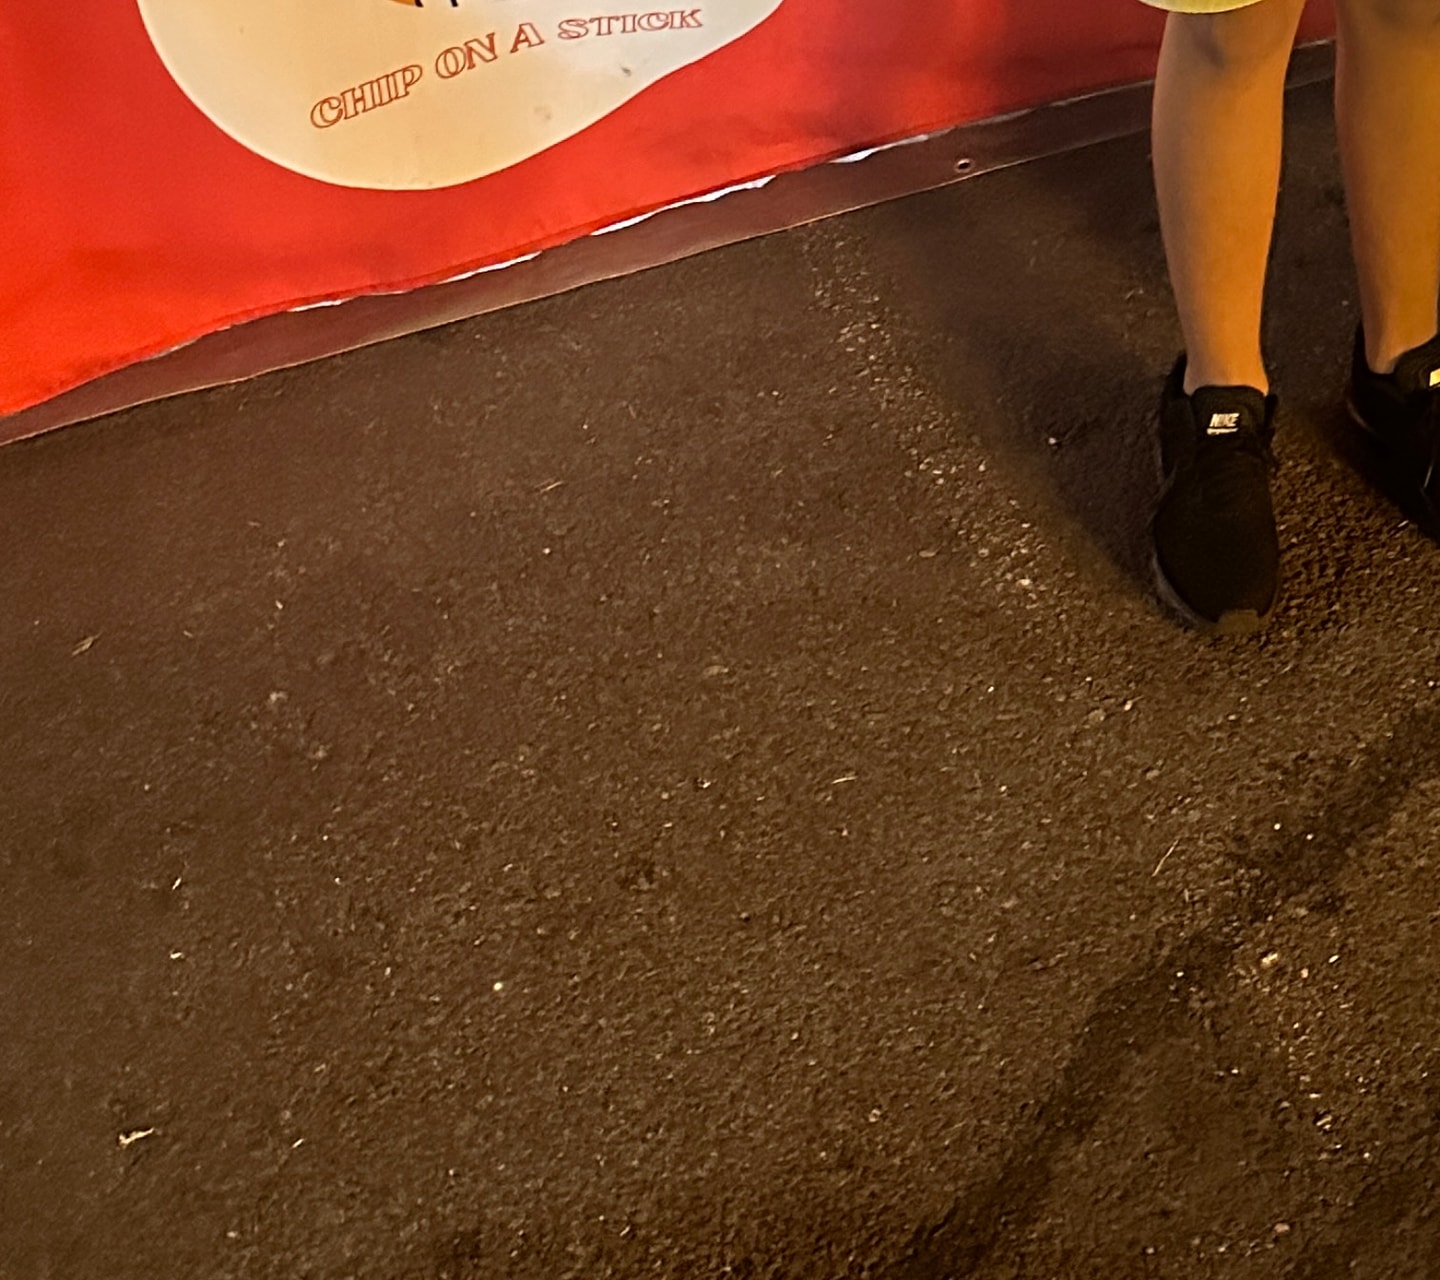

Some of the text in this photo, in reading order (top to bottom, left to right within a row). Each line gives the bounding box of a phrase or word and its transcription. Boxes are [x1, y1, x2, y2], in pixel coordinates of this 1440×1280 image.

[309, 9, 703, 129] CHIP ON A STICK
